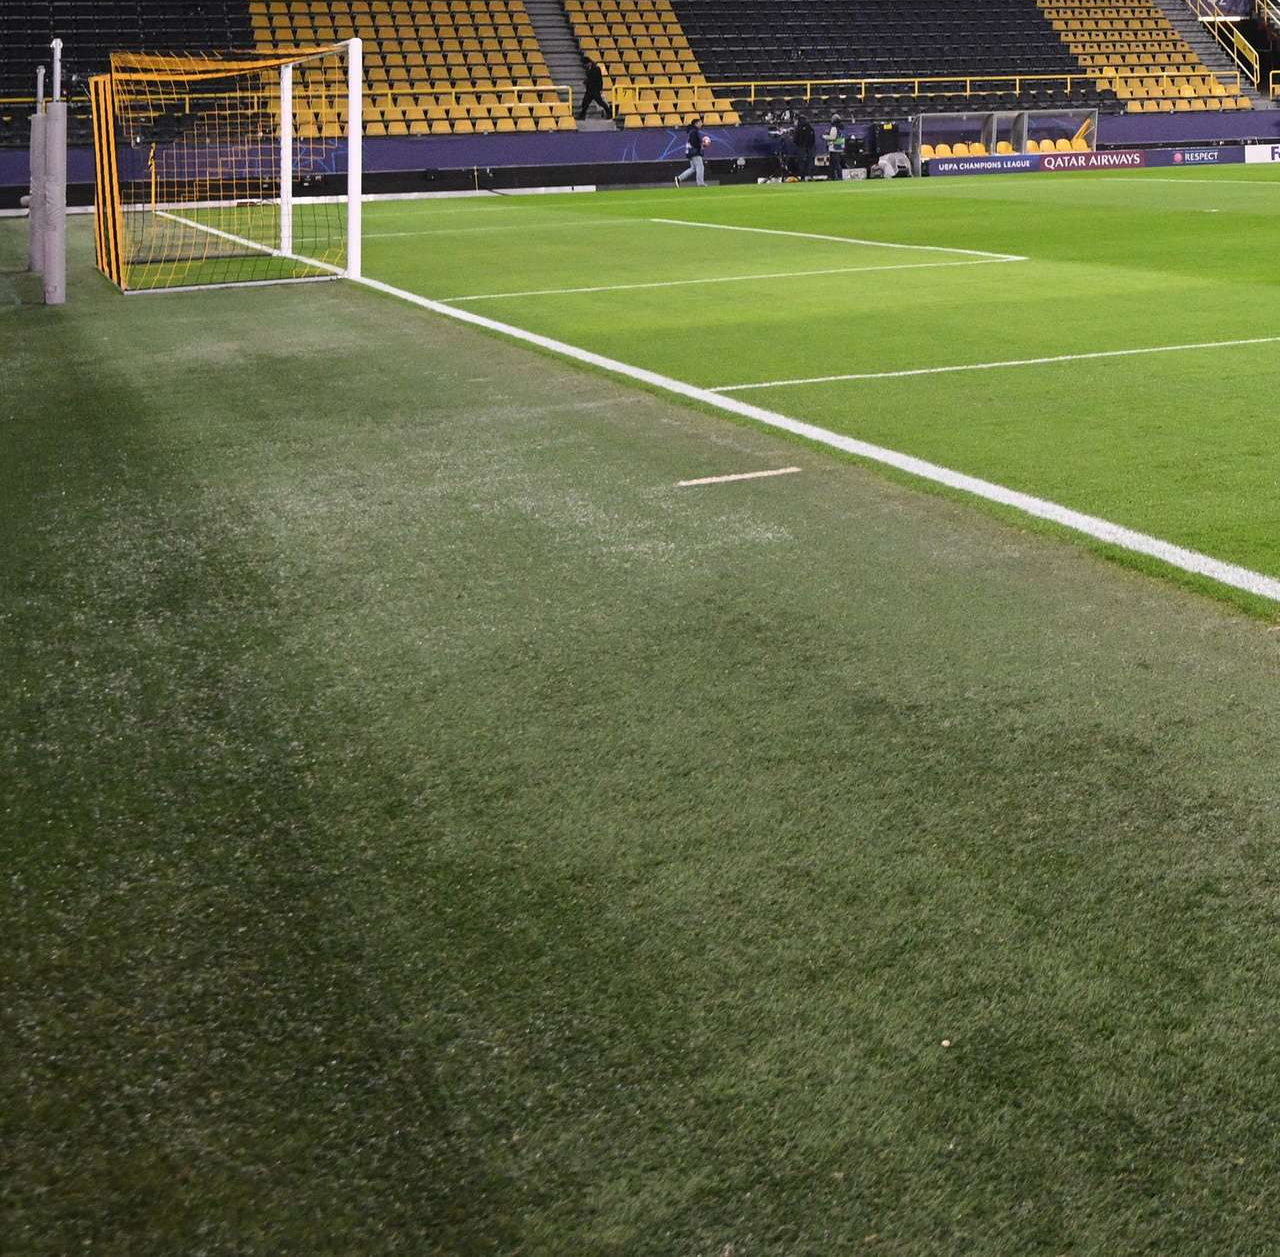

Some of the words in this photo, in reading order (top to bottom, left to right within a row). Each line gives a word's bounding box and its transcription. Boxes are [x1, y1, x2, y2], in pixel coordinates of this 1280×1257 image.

[1044, 156, 1086, 170] QATAR
[1089, 153, 1140, 167] AIRWAYS
[1185, 152, 1219, 161] RESPECT
[938, 162, 958, 171] UEFA
[959, 160, 1001, 170] CHAMPIONS
[1003, 159, 1031, 168] LEAGUE
